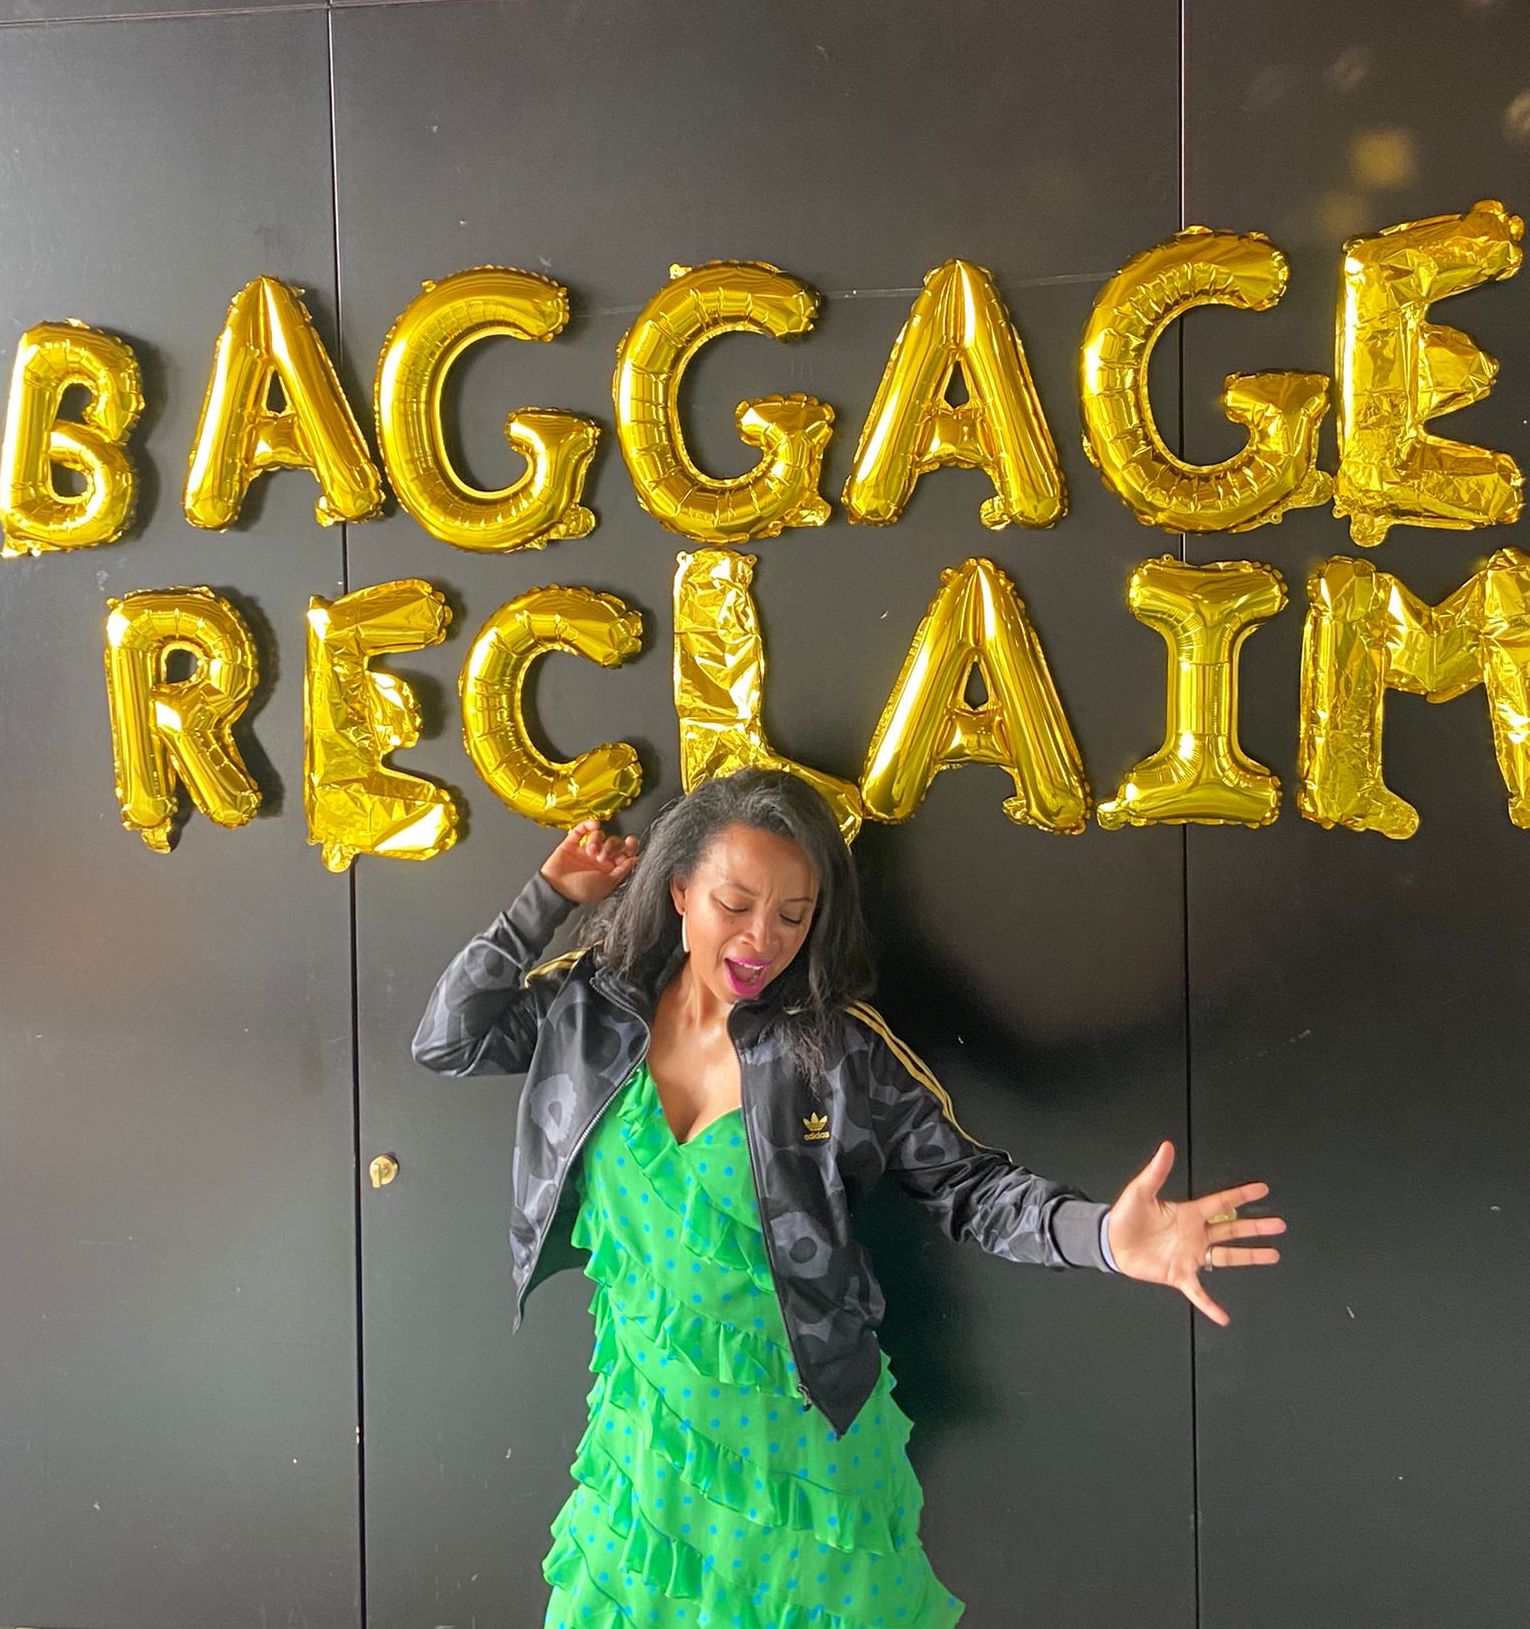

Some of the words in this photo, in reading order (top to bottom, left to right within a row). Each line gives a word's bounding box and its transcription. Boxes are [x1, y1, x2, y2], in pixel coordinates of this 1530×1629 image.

[0, 200, 1526, 558] BAGGAGE
[104, 547, 1530, 872] RECLAIM
[804, 1131, 830, 1140] adidas
